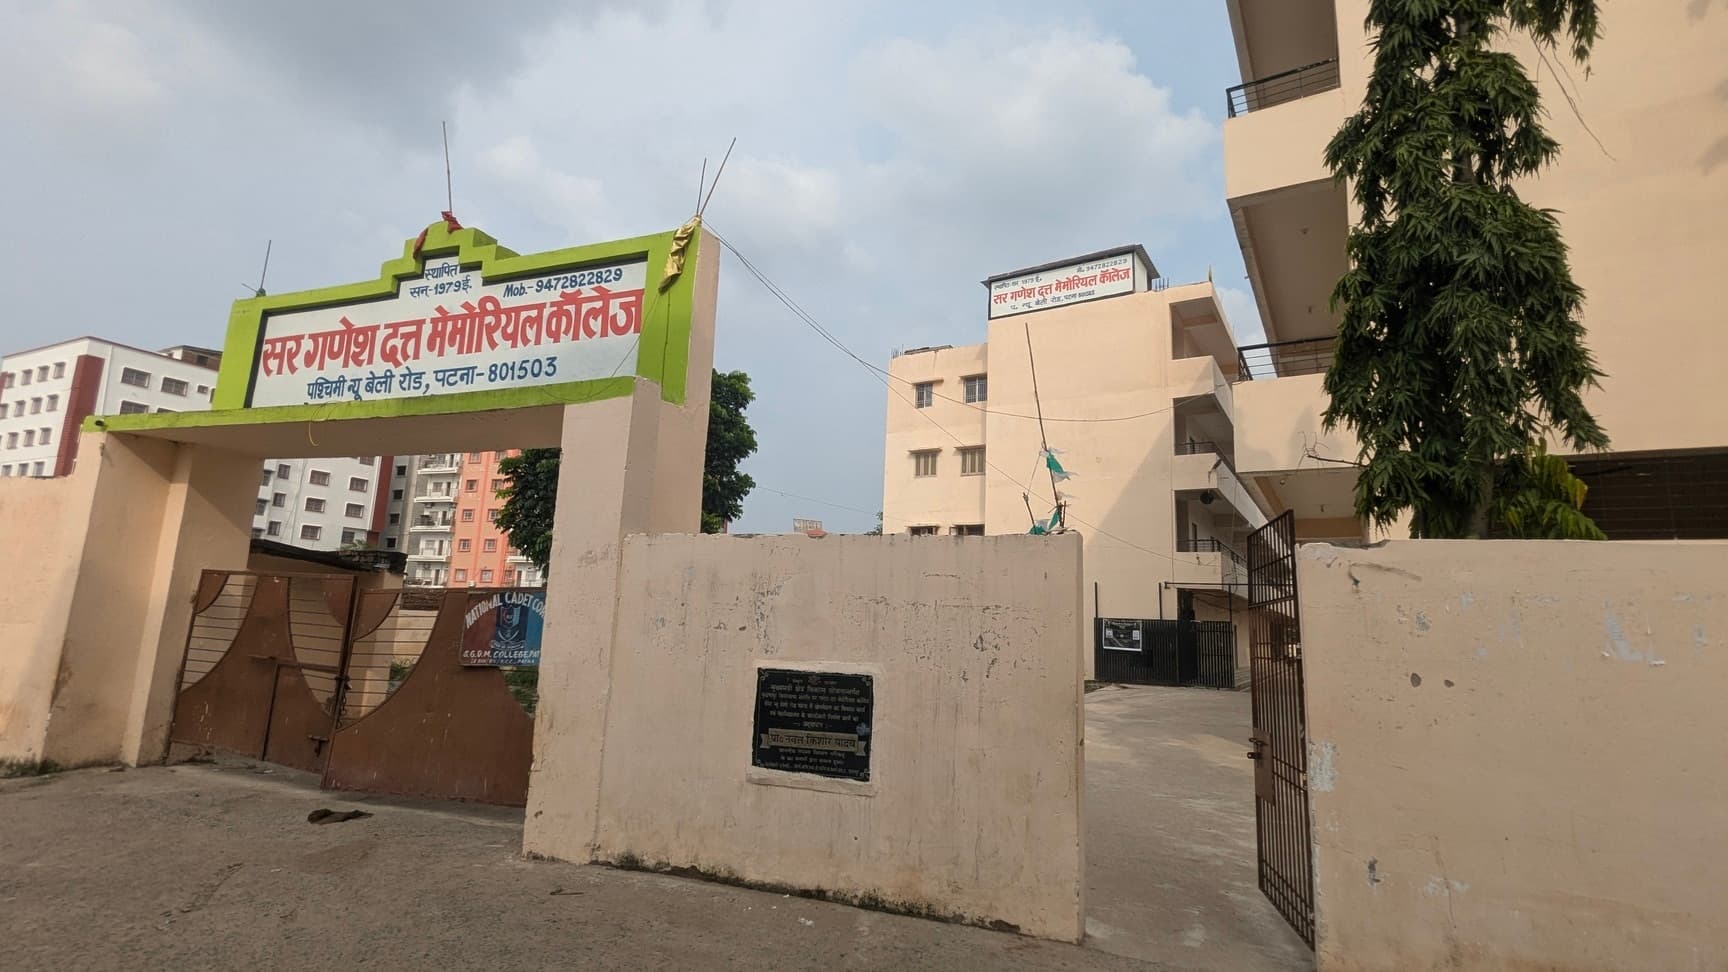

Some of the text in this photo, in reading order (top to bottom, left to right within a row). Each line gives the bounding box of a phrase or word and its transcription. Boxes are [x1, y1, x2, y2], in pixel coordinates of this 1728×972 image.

[425, 261, 458, 280] स्थापित
[993, 267, 1131, 305] सर गणेश दत्त मेमोरियल कॉलेज
[262, 286, 645, 377] सर गणेश दत्त मेमोरियल कॉलेज
[307, 374, 347, 400] पश्चिमी
[348, 377, 363, 402] न्यू
[365, 368, 395, 394] बेली
[465, 593, 503, 629] NATIONAL
[505, 591, 534, 608] CADET
